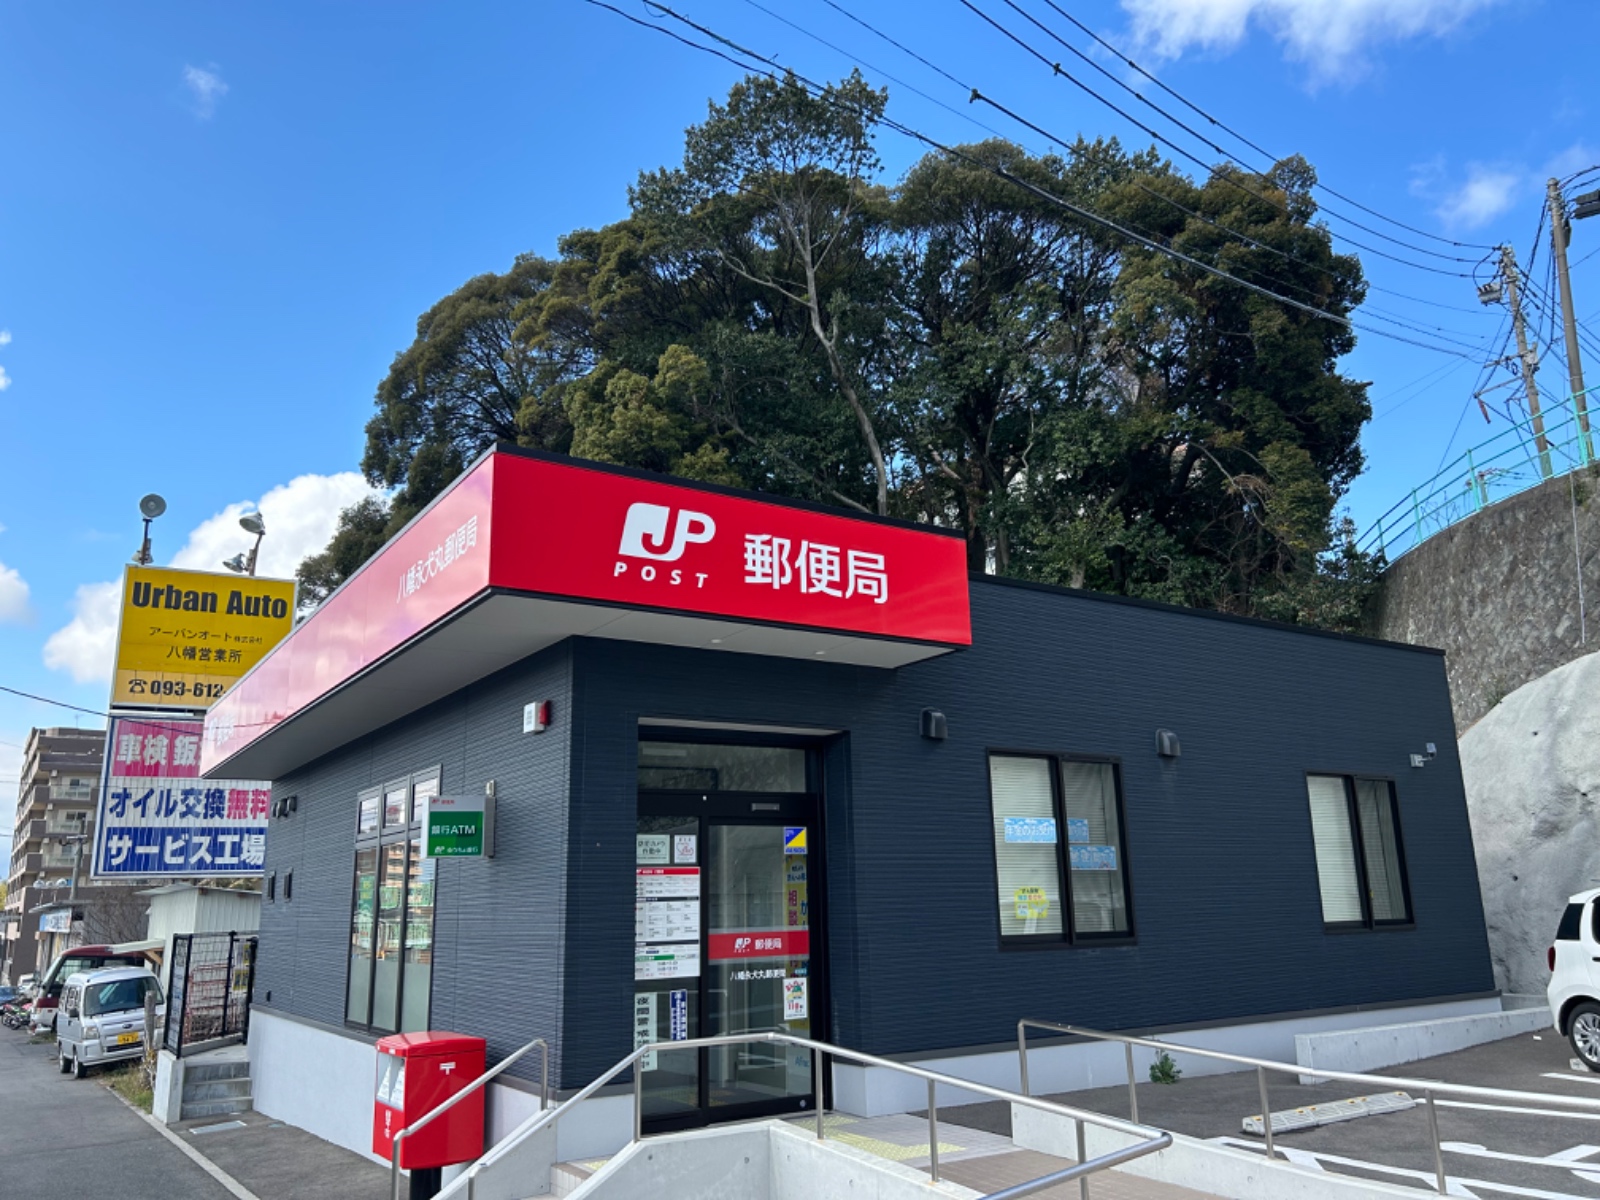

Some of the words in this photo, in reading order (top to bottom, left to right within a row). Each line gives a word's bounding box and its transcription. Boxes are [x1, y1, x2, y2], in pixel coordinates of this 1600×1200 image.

[613, 561, 708, 588] POST
[744, 533, 888, 604] 郵便局
[131, 581, 218, 613] Urban
[225, 590, 288, 619] Auto
[166, 645, 242, 664] 八幡営業所
[116, 733, 169, 766] 車検
[173, 735, 201, 766] 鈑
[108, 787, 271, 820] オイル交換無料
[431, 825, 476, 836] 銀行ATM
[107, 833, 266, 866] サービス工場
